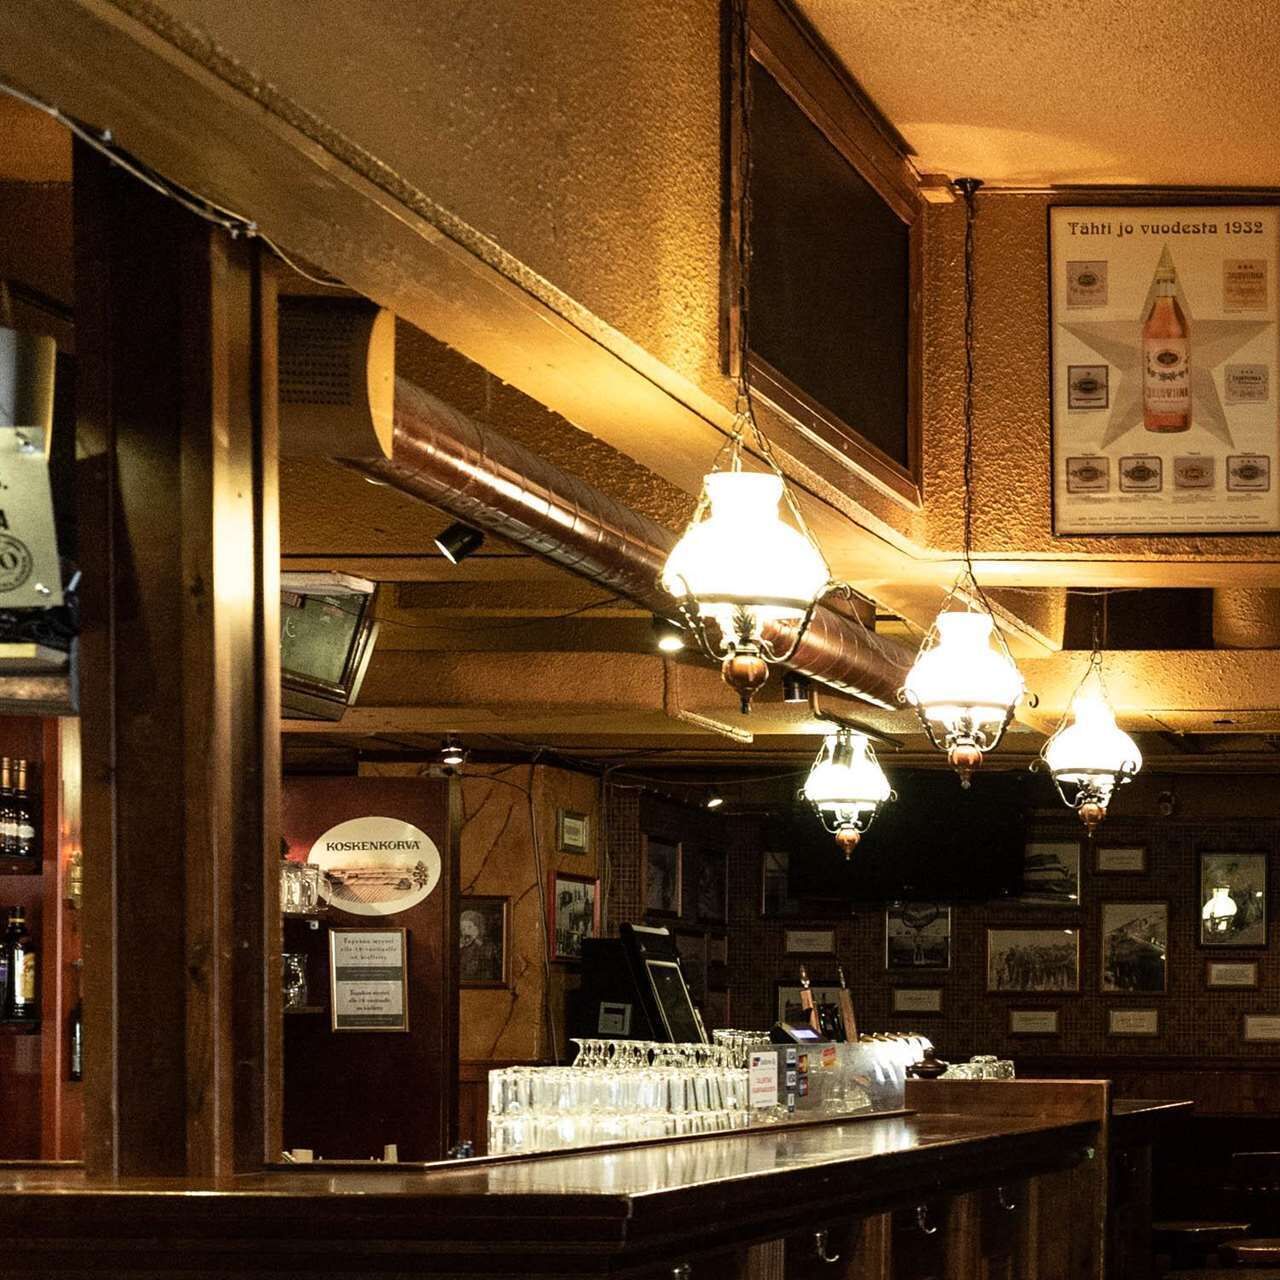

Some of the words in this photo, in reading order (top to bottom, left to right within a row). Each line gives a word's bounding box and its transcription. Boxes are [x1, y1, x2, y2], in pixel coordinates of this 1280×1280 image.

[1067, 221, 1112, 236] Tähti
[1116, 222, 1134, 238] jo
[1139, 221, 1218, 235] vuodesta
[1224, 221, 1264, 234] 1932
[325, 840, 420, 852] KOSKENKORVA
